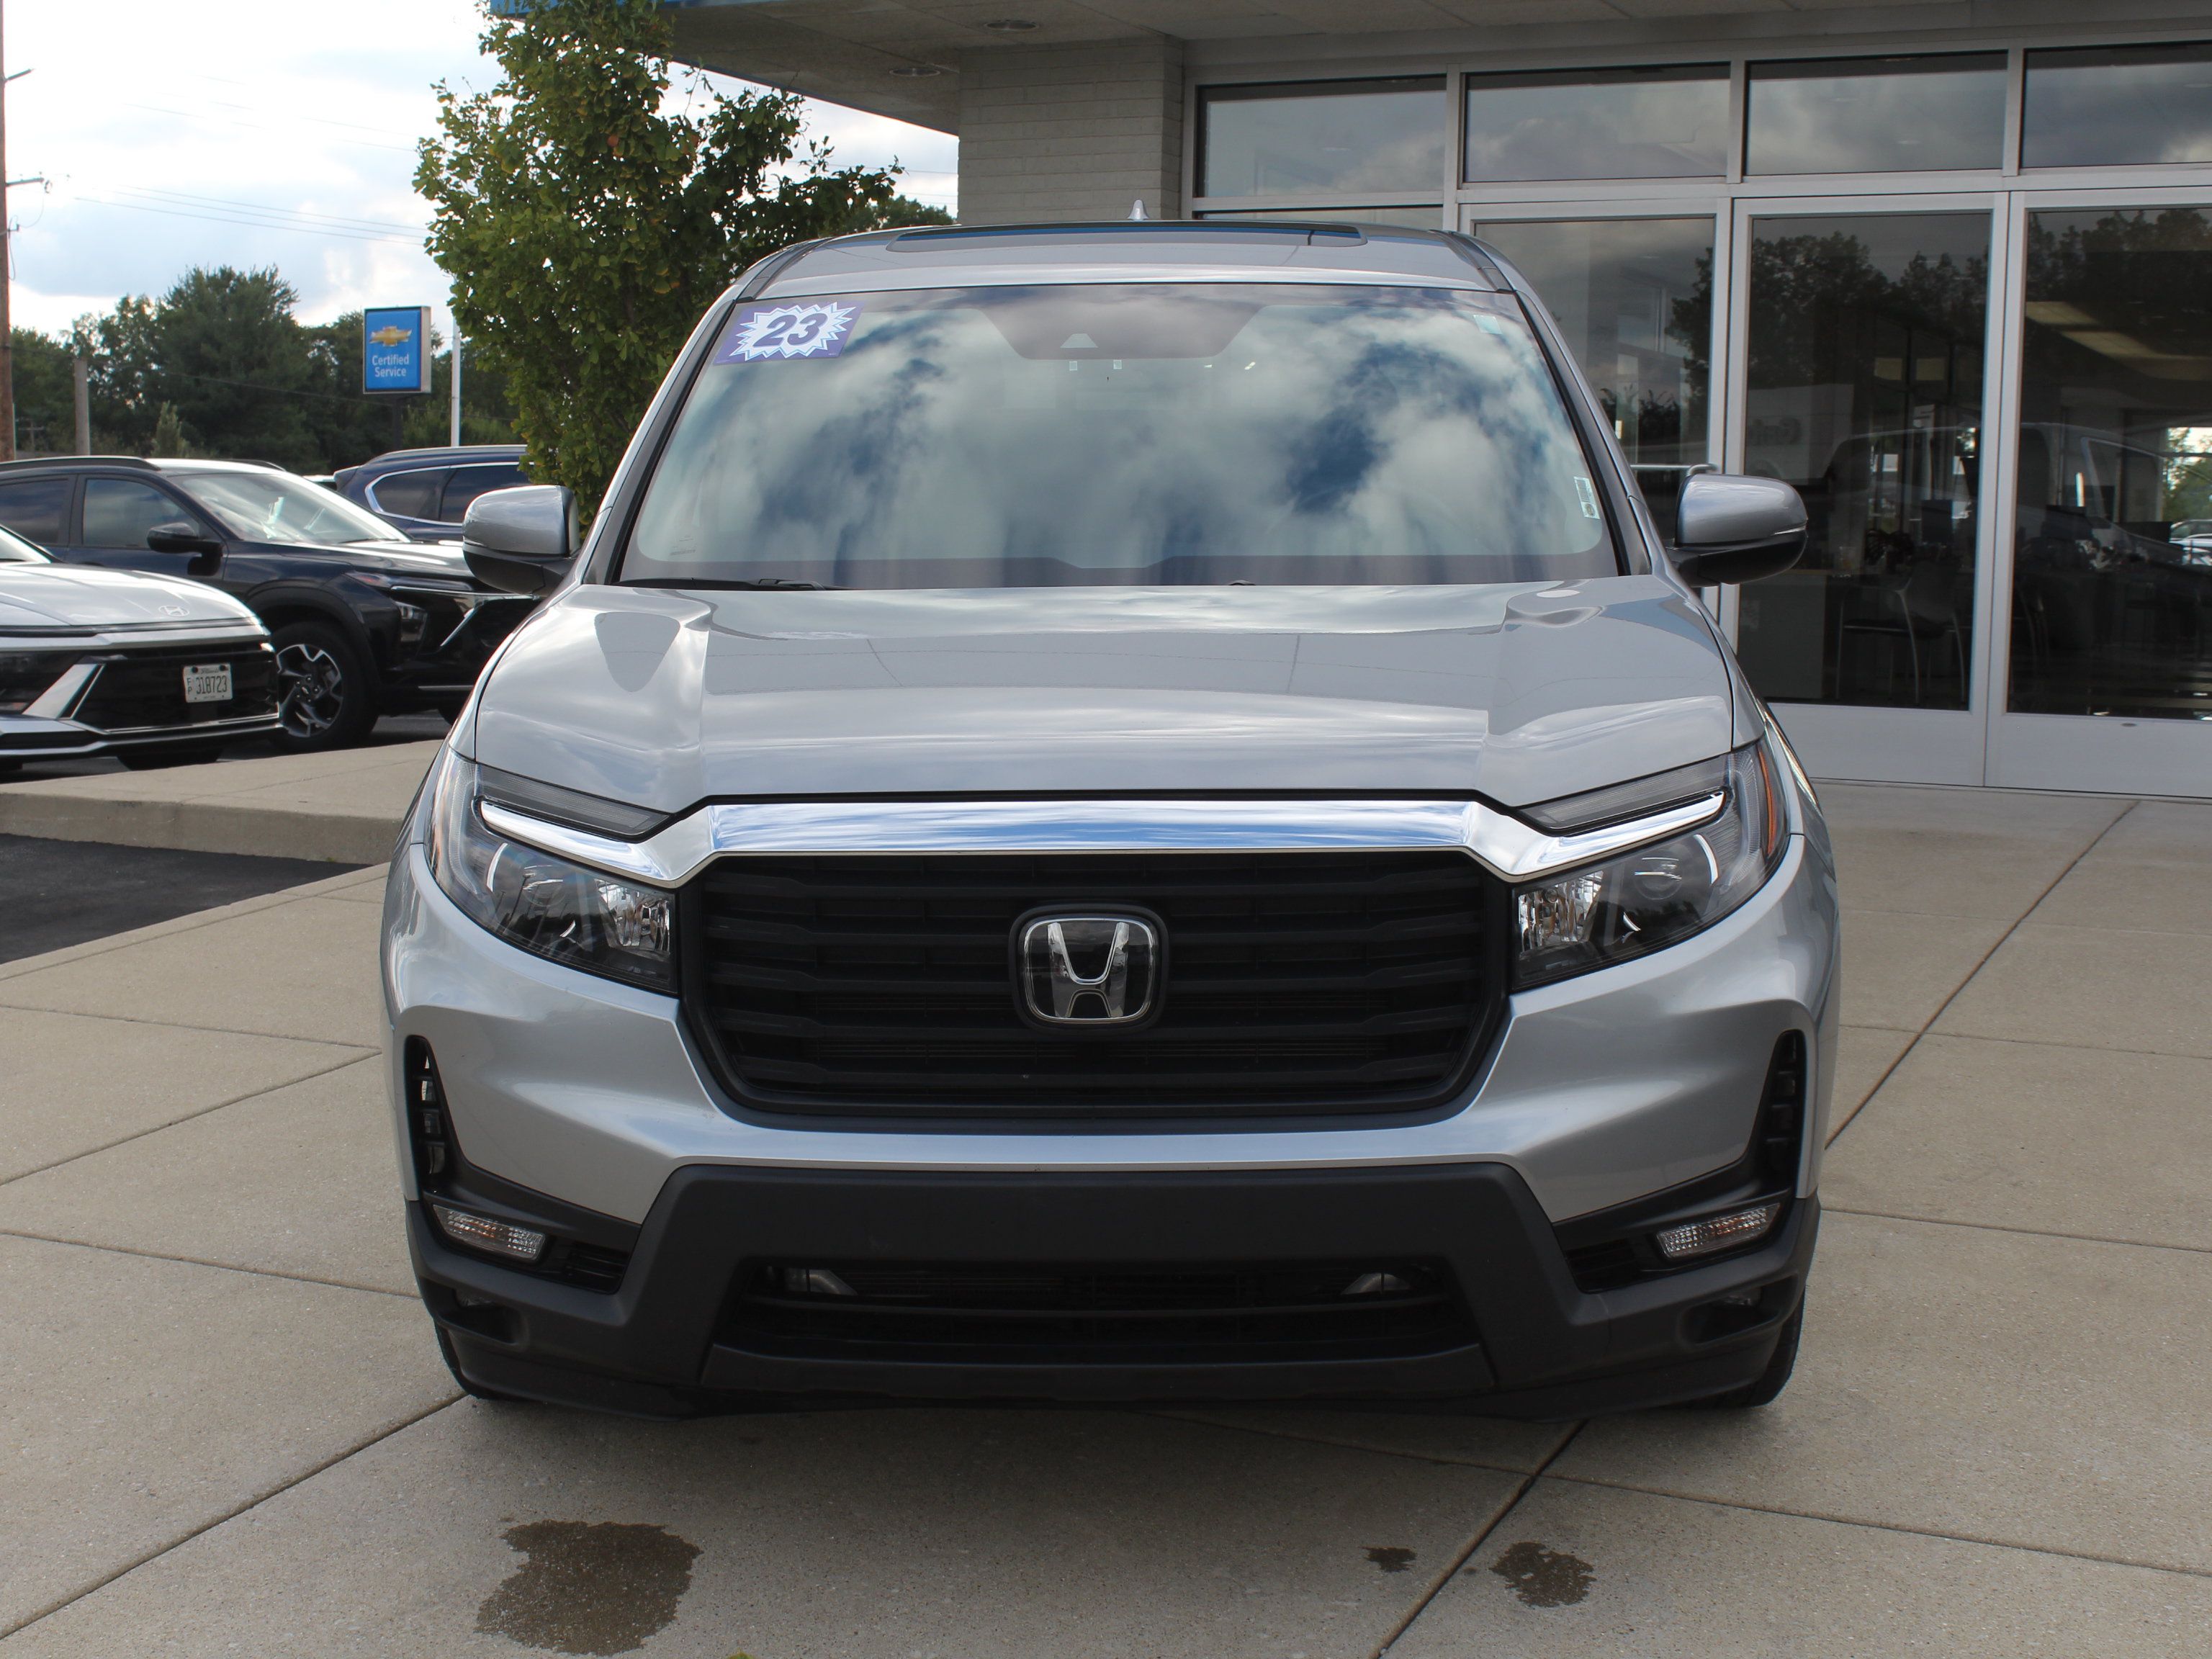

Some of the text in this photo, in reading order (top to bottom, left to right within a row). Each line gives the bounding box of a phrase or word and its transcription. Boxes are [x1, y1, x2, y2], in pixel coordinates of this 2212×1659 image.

[752, 313, 829, 348] 23
[372, 354, 410, 366] Certified
[374, 367, 407, 377] Service
[196, 675, 228, 694] 318723
